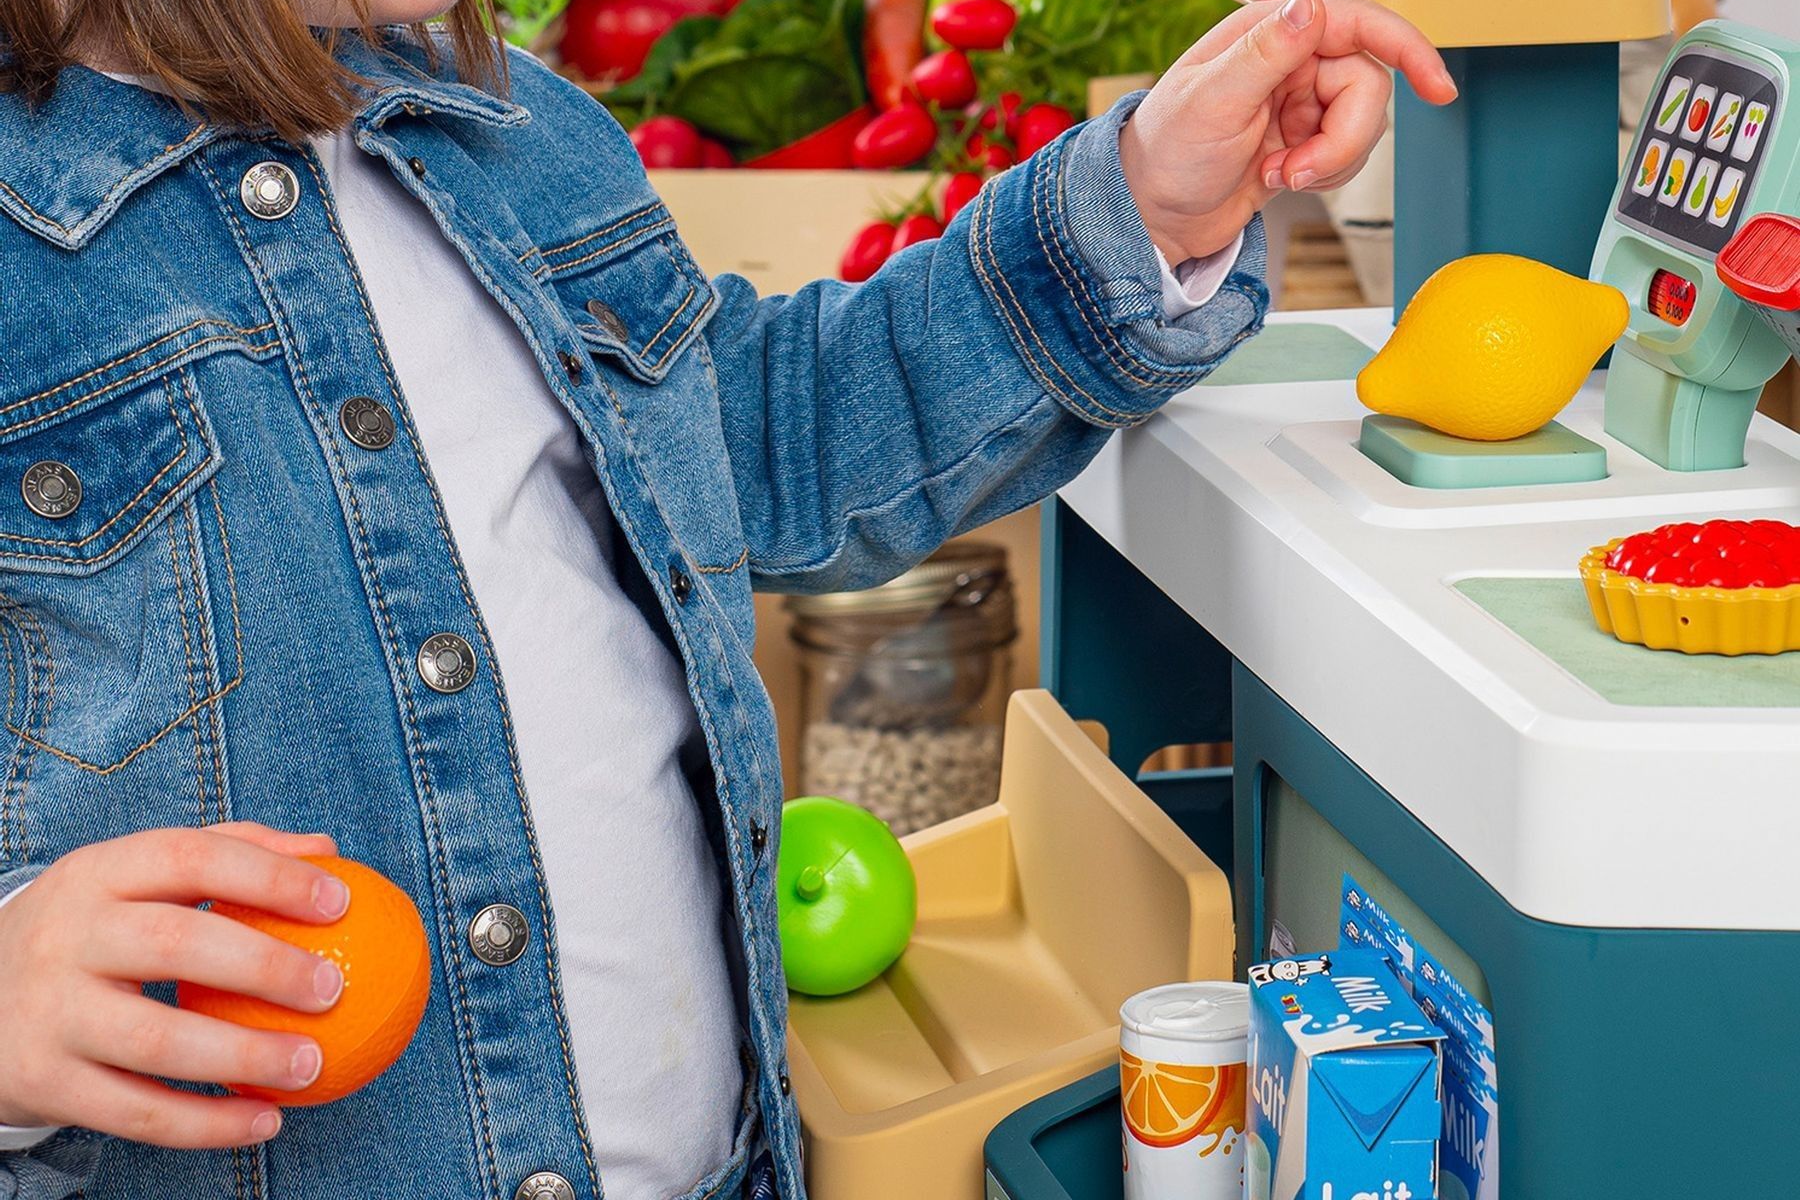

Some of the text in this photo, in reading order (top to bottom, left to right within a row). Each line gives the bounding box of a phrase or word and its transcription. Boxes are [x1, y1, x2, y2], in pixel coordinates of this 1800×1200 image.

[1365, 897, 1390, 927] Milk
[1363, 929, 1386, 950] Mil
[1331, 976, 1392, 1014] Milk
[1440, 969, 1466, 1001] Milk
[1441, 1005, 1469, 1039] Milk
[1443, 1042, 1470, 1077] Milk
[1253, 1031, 1286, 1137] Lait
[1442, 1084, 1486, 1181] Milk
